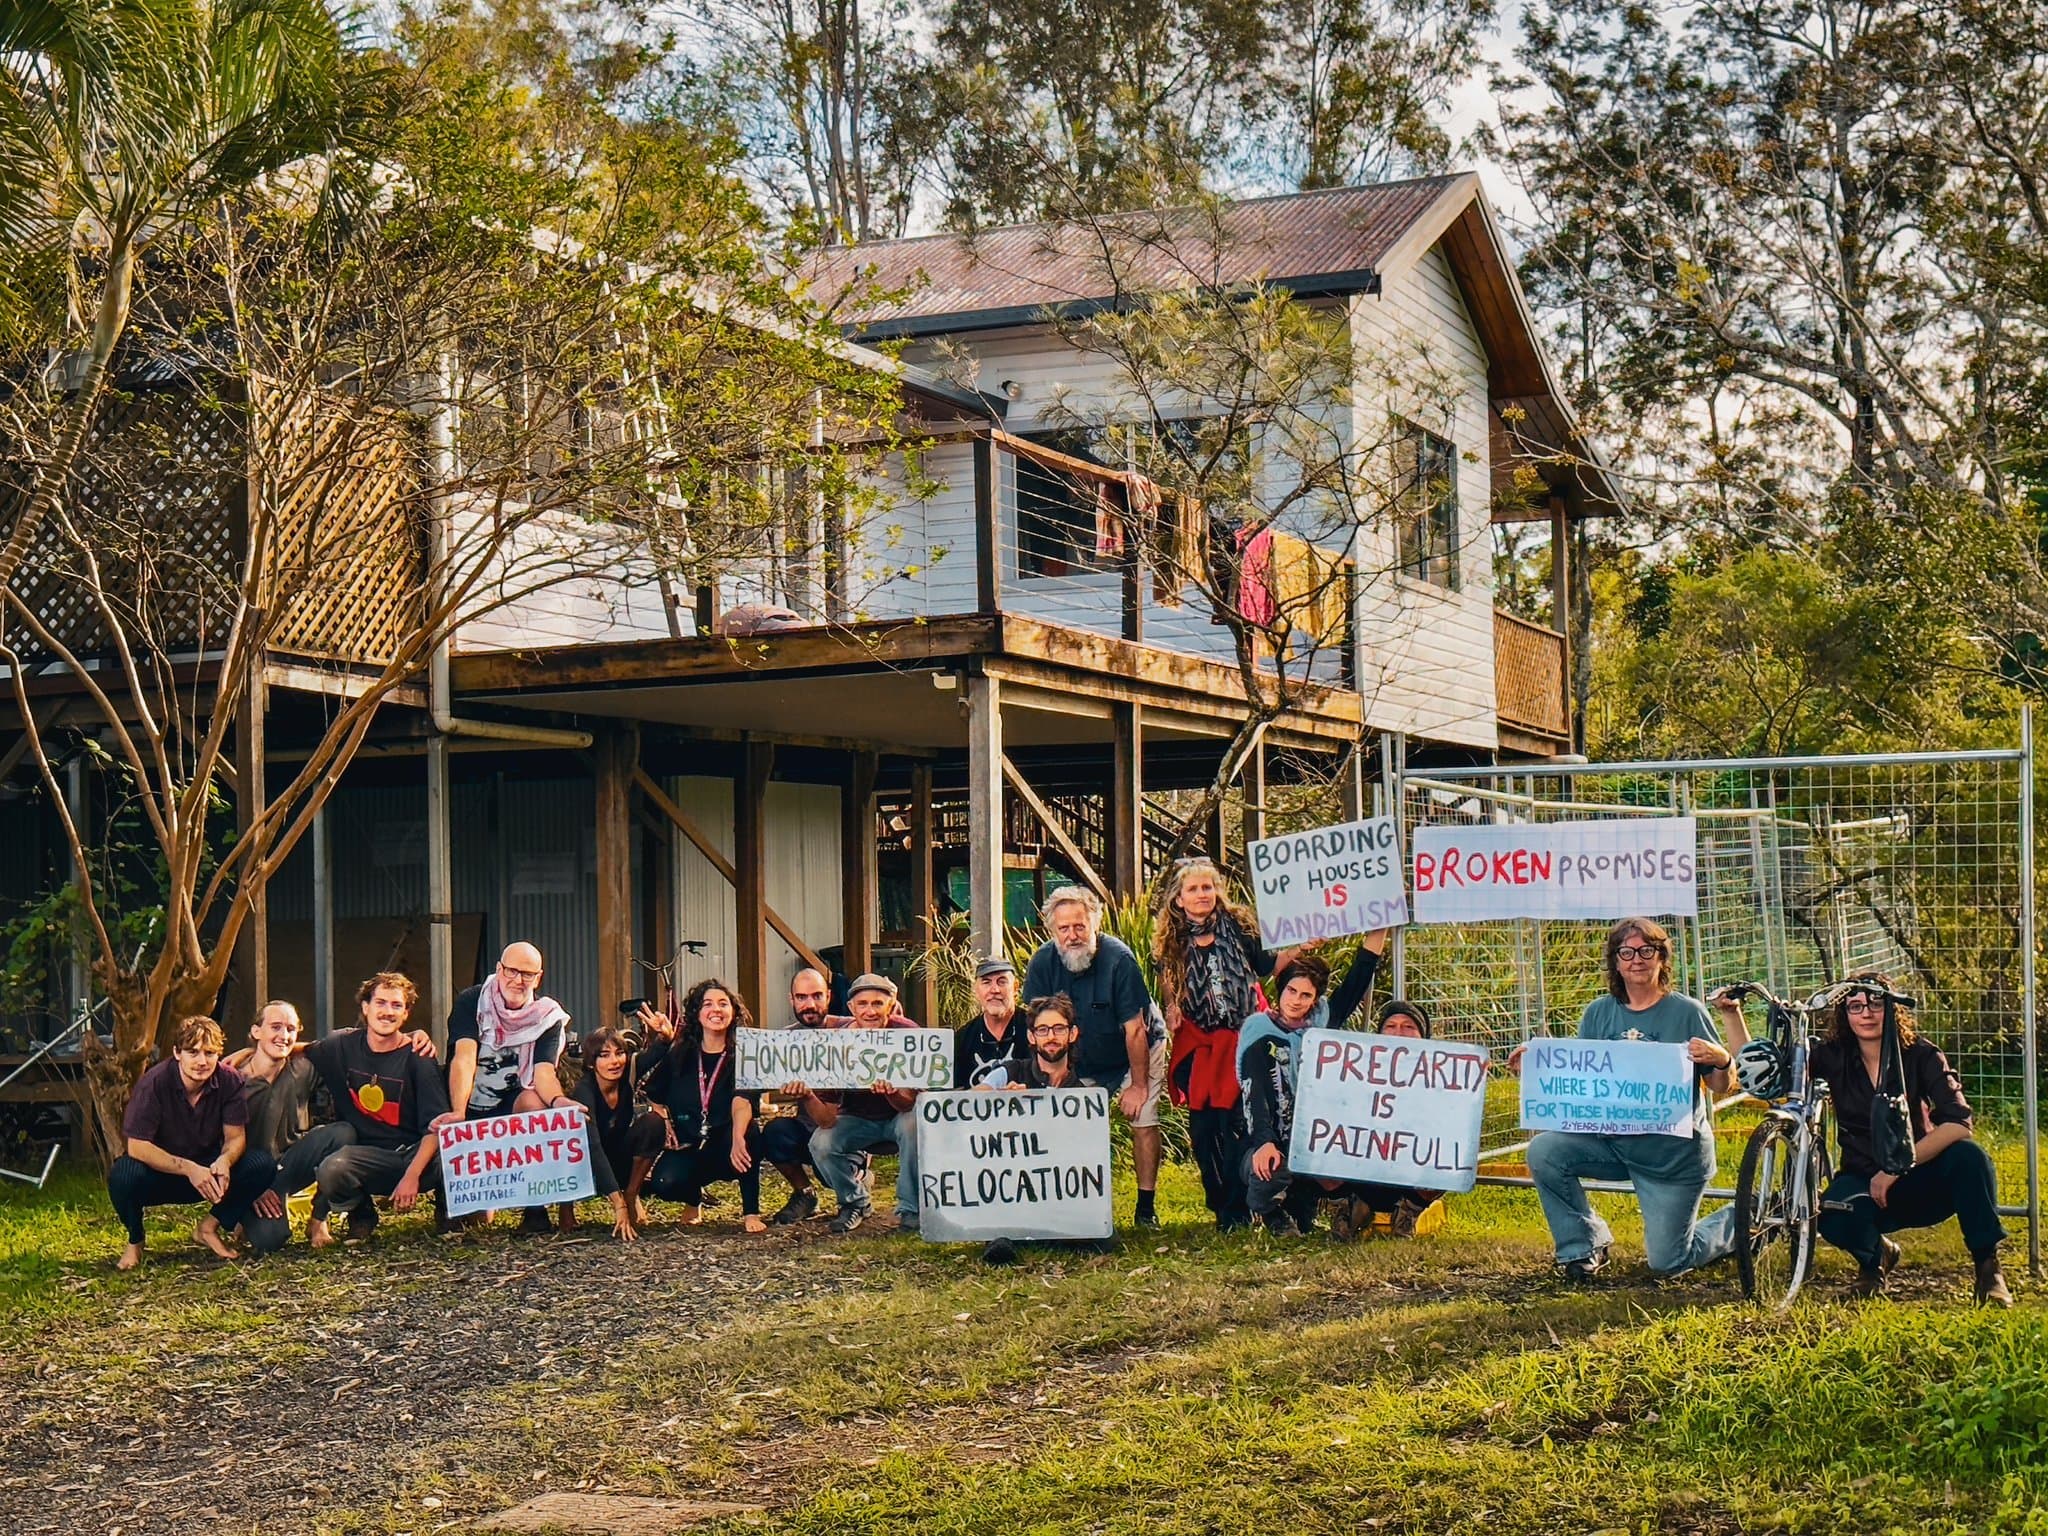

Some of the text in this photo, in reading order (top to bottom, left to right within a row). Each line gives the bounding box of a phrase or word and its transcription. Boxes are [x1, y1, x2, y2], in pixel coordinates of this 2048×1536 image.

[1254, 821, 1396, 872] BOARDING
[1262, 855, 1389, 896] UP HOUSES
[1415, 848, 1693, 891] BROKEN PROMISES
[1323, 883, 1347, 907] IS
[1260, 895, 1408, 945] VANDALISM
[868, 1030, 942, 1053] THE BIG
[740, 1040, 951, 1086] HONOURING SCRUB
[1315, 1040, 1489, 1092] PRECARITY
[1536, 1046, 1613, 1073] NSWRA
[1371, 1091, 1396, 1119] IS
[1539, 1076, 1691, 1105] WHERE IS YOUR PLAN
[923, 1093, 1105, 1123] OCCUPATION
[1525, 1099, 1672, 1121] FOR THESE HOUSES?
[440, 1109, 582, 1149] INFORMAL
[1572, 1121, 1599, 1131] YEARS
[1600, 1121, 1617, 1132] AND
[449, 1138, 584, 1176] TENANTS
[970, 1131, 1048, 1159] UNTIL
[1308, 1119, 1473, 1171] PAINFULL
[449, 1171, 525, 1193] PROTECTING
[454, 1176, 578, 1204] HABITABLE HOMES
[922, 1164, 1104, 1209] RELOCATION
